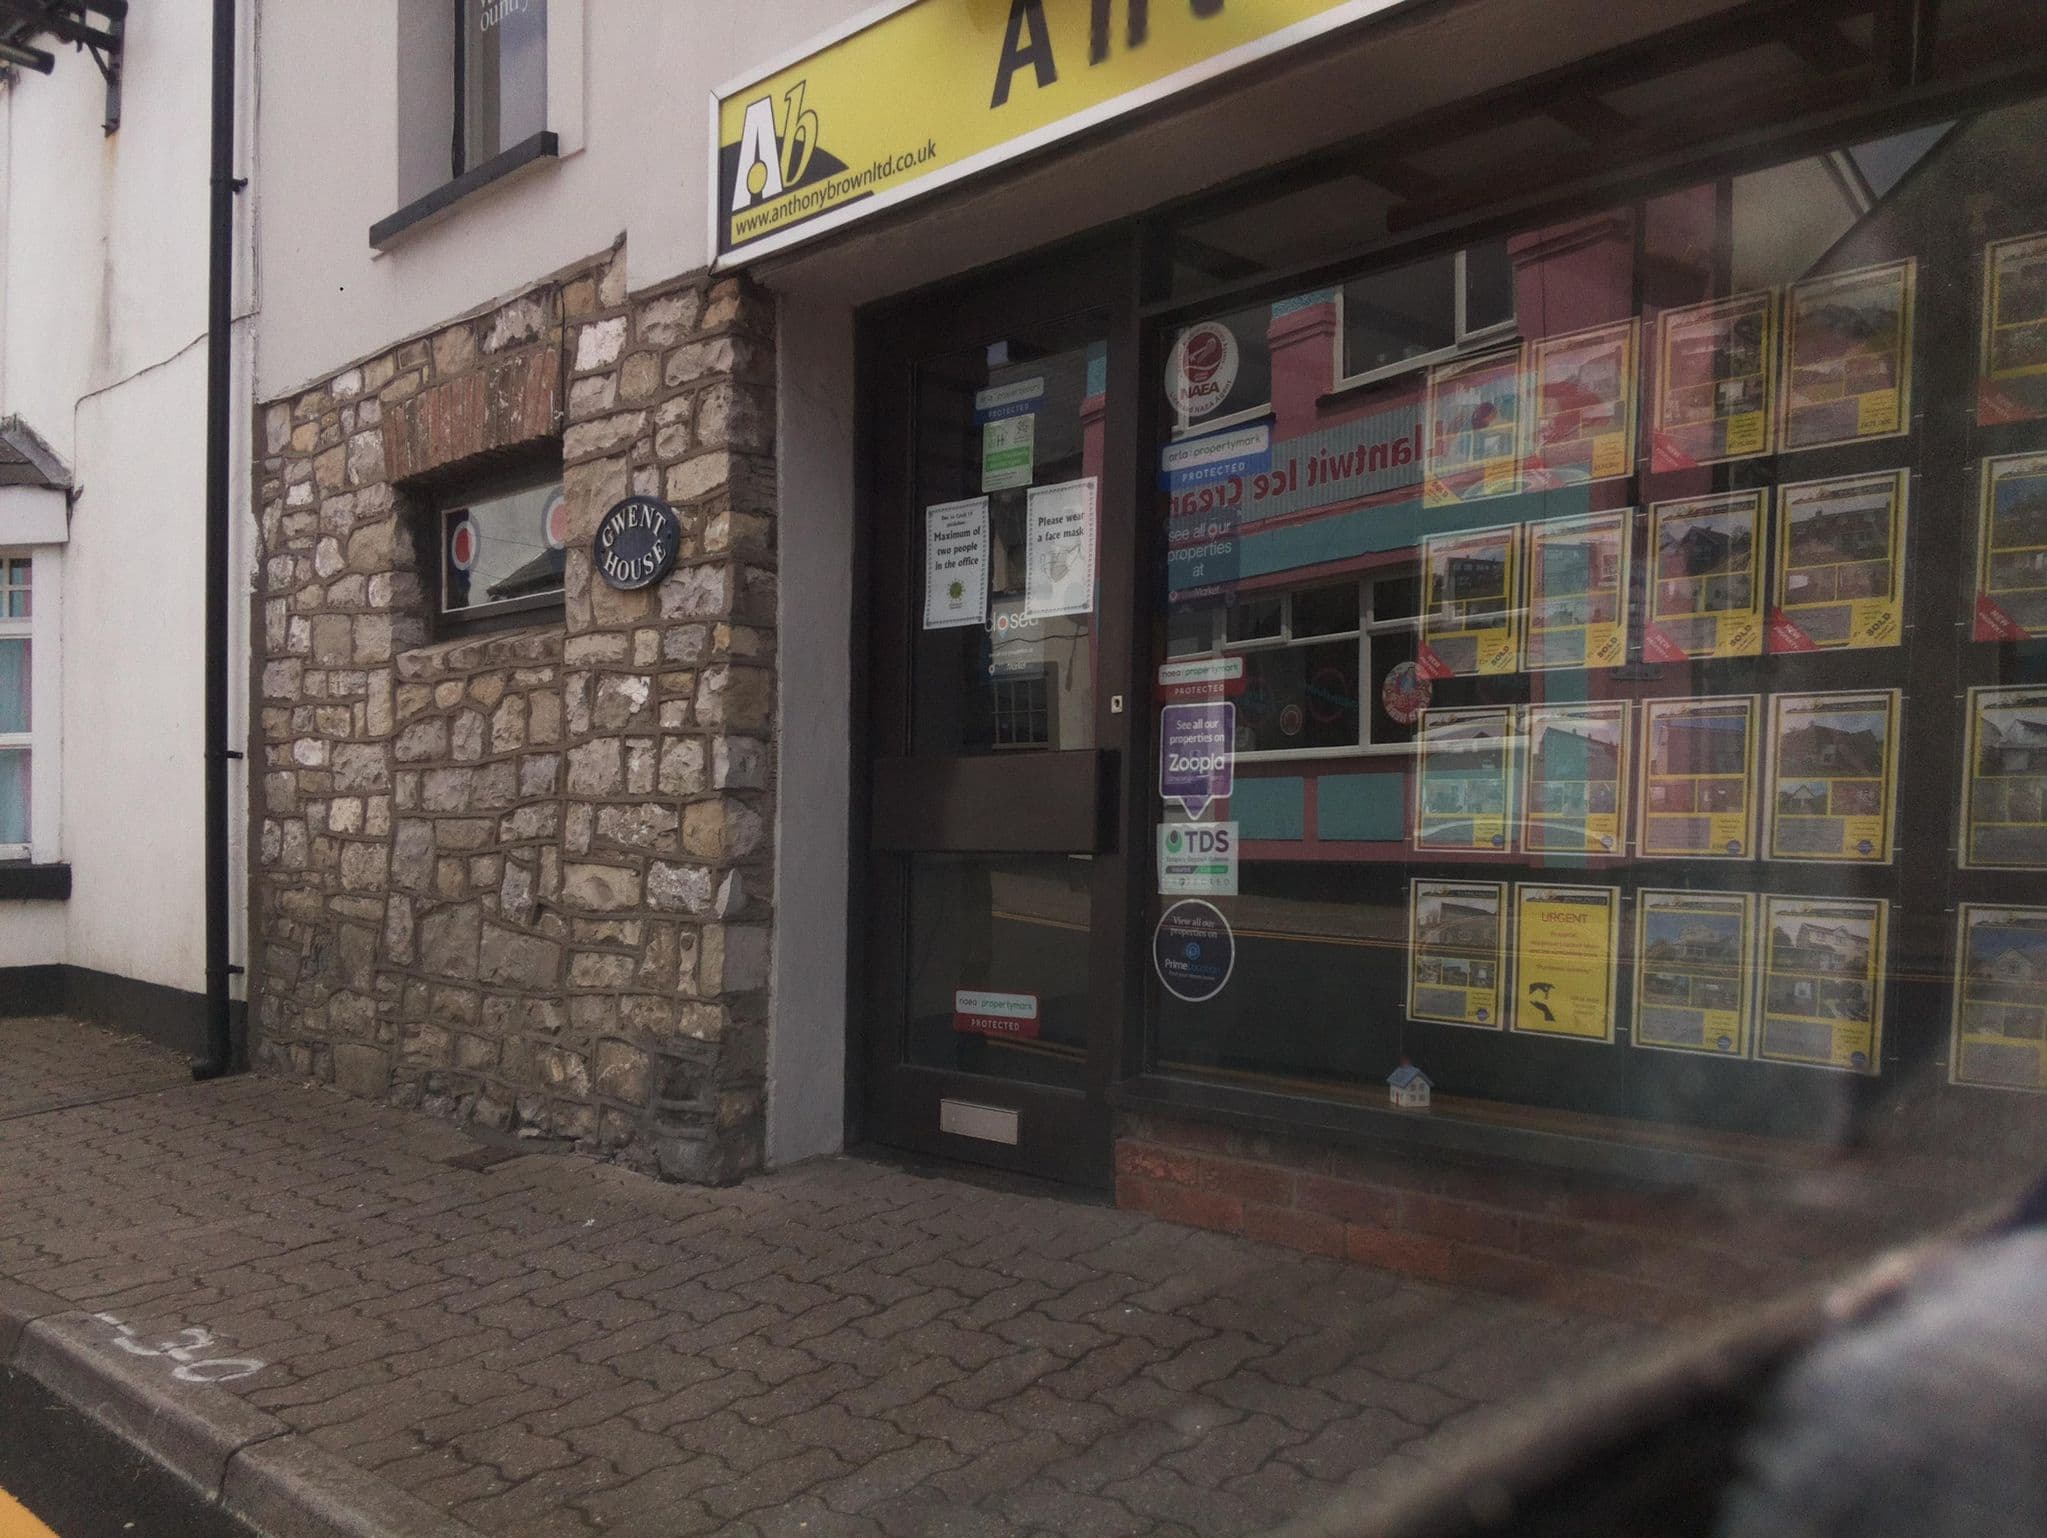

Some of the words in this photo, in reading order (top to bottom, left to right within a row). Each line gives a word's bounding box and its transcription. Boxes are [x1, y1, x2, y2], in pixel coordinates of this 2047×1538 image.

[735, 138, 937, 236] www.anthonybrownltd.co.uk
[1182, 462, 1246, 482] PROTECTED
[602, 504, 668, 548] GWENT
[1038, 516, 1063, 527] Please
[1066, 512, 1085, 522] wear
[934, 530, 971, 542] Maximum
[973, 526, 981, 536] of
[1045, 531, 1061, 541] face
[1063, 526, 1085, 538] mask
[1168, 528, 1190, 543] see
[1192, 522, 1205, 538] all
[1207, 521, 1232, 538] our
[937, 546, 952, 556] two
[953, 543, 978, 555] people
[1168, 541, 1233, 563] properties
[603, 539, 668, 581] HOUSE
[944, 558, 956, 569] the
[957, 556, 979, 567] office
[1192, 562, 1205, 577] at
[1174, 684, 1225, 695] PROTECTED
[1176, 720, 1192, 730] See
[1192, 719, 1203, 730] all
[1204, 719, 1220, 729] our
[1169, 733, 1213, 746] properties
[1214, 733, 1225, 742] on
[1168, 752, 1225, 775] Zoopla
[1184, 830, 1229, 853] TDS
[1173, 916, 1191, 926] View
[1191, 917, 1202, 927] all
[1541, 911, 1588, 923] URGENT
[970, 1018, 1020, 1031] PROTECTED
